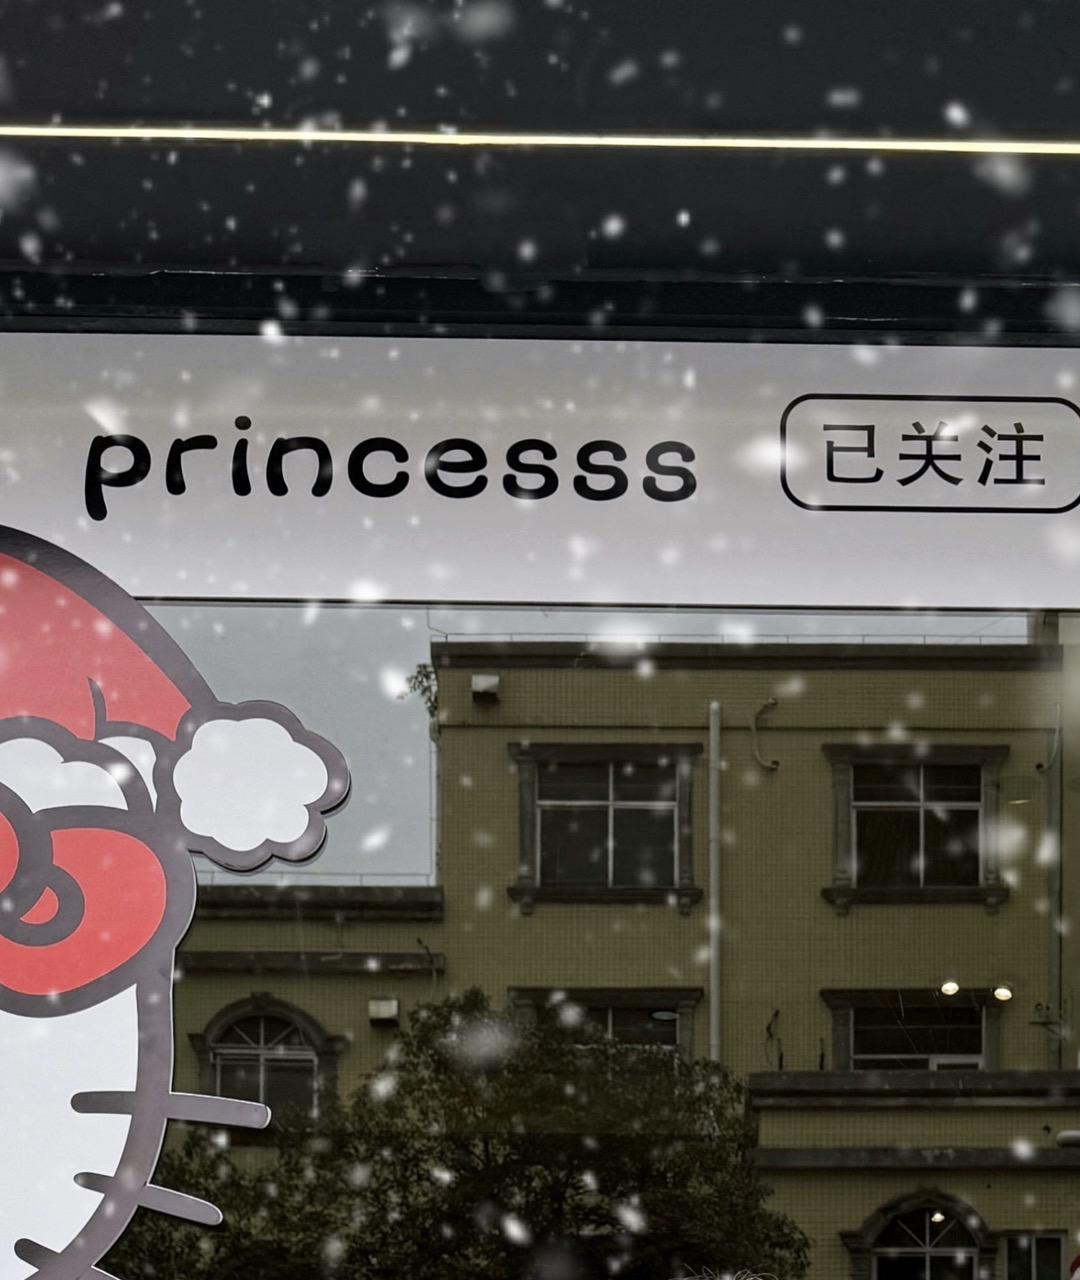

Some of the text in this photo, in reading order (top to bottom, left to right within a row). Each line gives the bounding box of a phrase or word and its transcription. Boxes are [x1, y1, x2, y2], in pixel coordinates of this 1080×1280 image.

[85, 416, 1046, 521] princesss 已关注
